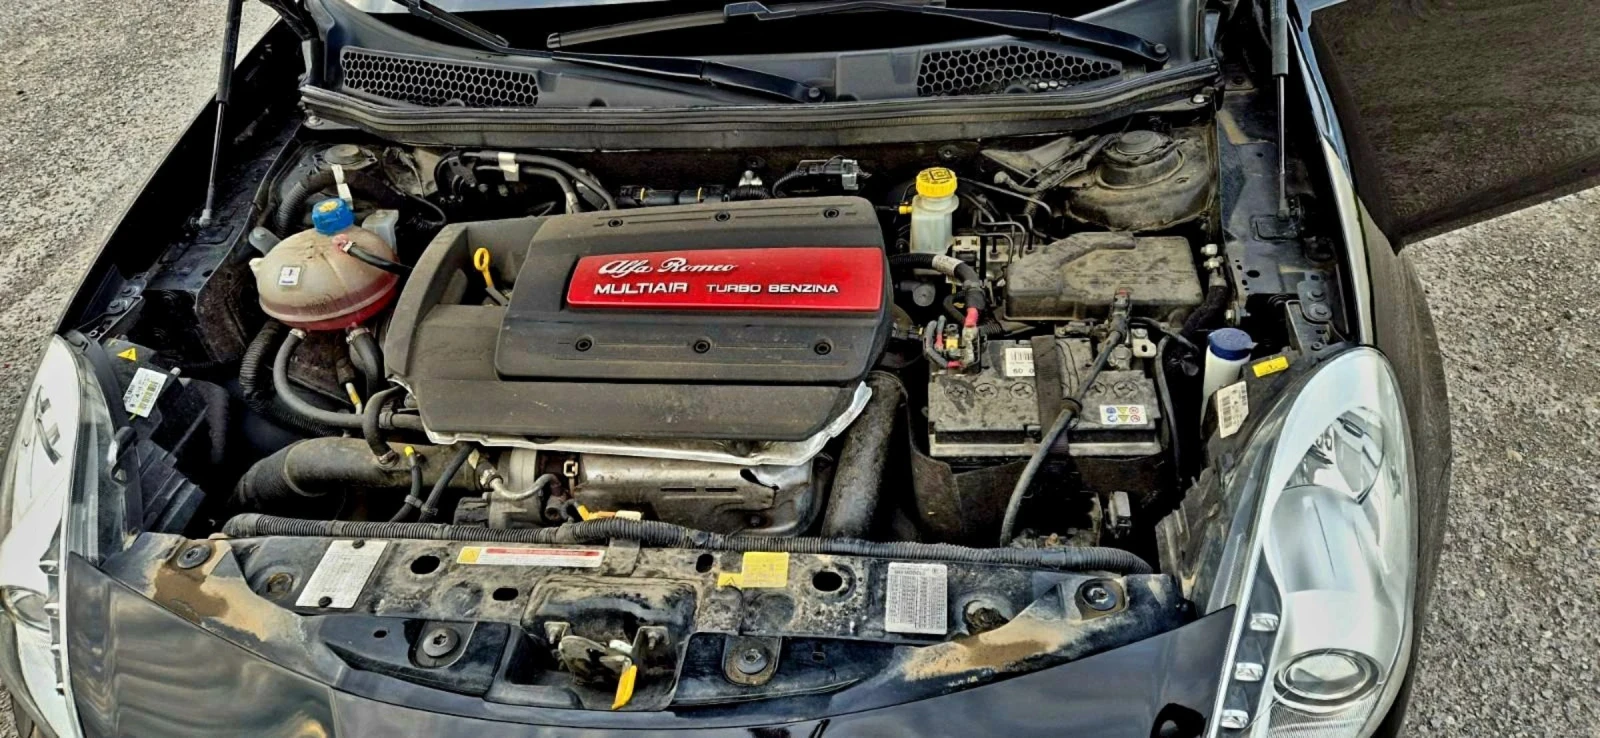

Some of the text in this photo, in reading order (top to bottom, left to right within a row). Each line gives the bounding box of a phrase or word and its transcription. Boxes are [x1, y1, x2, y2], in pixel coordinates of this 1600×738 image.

[598, 257, 738, 278] Alfa Romeo
[594, 282, 838, 295] MULTIAIR TURBO BENZINA
